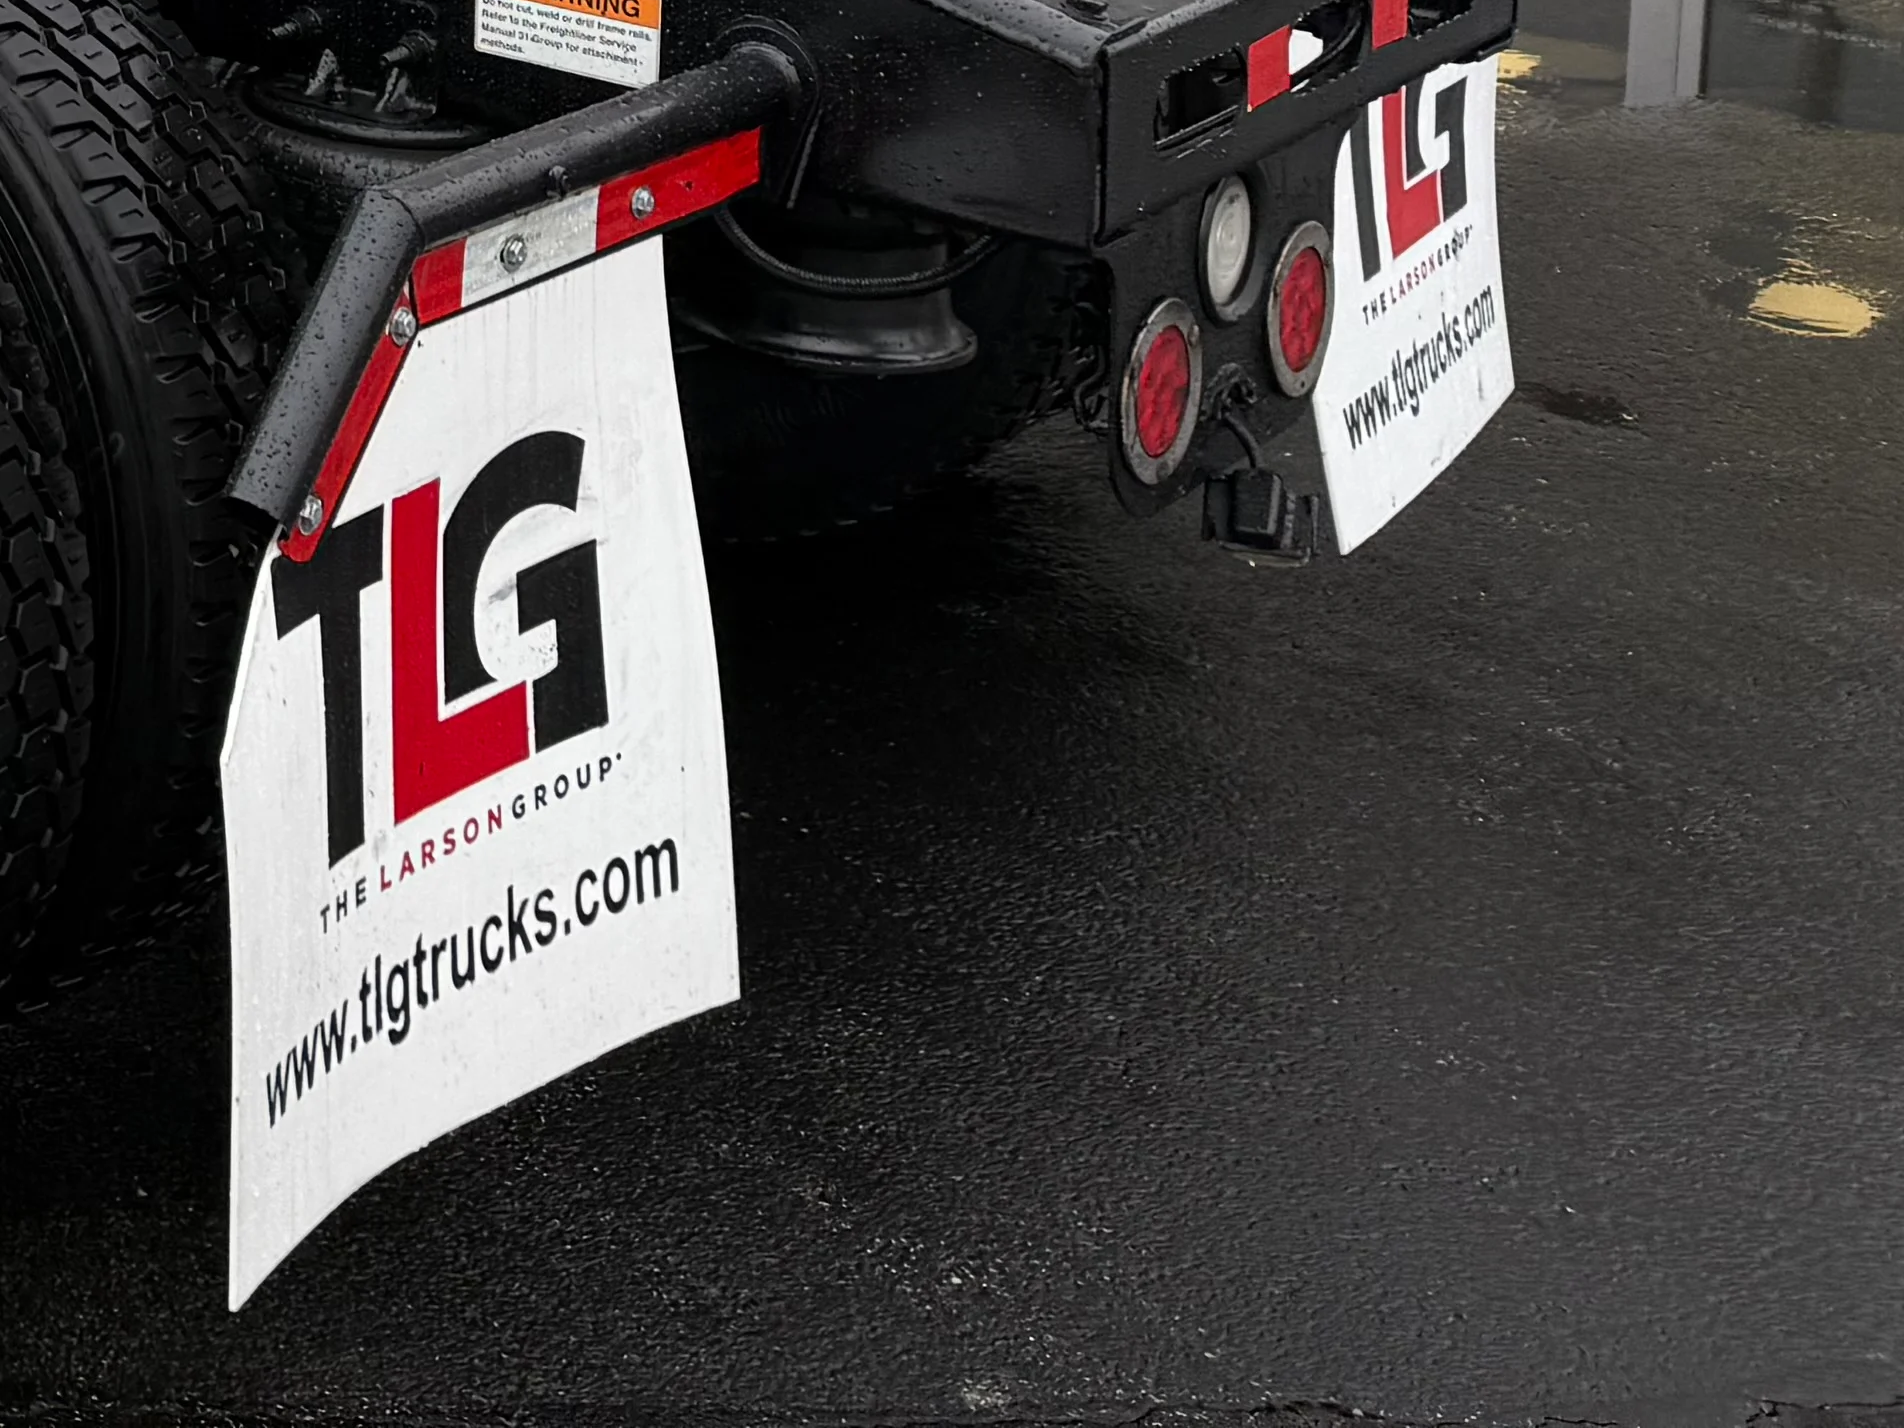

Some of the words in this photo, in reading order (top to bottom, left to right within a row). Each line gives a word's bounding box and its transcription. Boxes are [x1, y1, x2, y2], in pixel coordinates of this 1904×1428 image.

[481, 8, 508, 22] Refer
[508, 14, 520, 25] to
[521, 19, 538, 30] the
[539, 22, 597, 42] Freightliner
[599, 35, 637, 53] Service
[481, 22, 516, 38] Manual
[565, 42, 580, 52] for
[582, 46, 638, 66] attachment
[497, 0, 514, 10] not
[537, 9, 560, 20] weld
[561, 15, 573, 24] or
[575, 17, 595, 29] drill
[597, 21, 626, 36] frame
[1362, 291, 1388, 326] THE
[1389, 253, 1436, 305] LARSON
[1343, 284, 1496, 451] www.tlgtrucks.com
[270, 429, 610, 870] TLG
[319, 875, 368, 935] THE
[379, 803, 504, 894] LARSON
[511, 754, 614, 821] GROUP
[265, 837, 681, 1130] www.tlgtrucks.com
